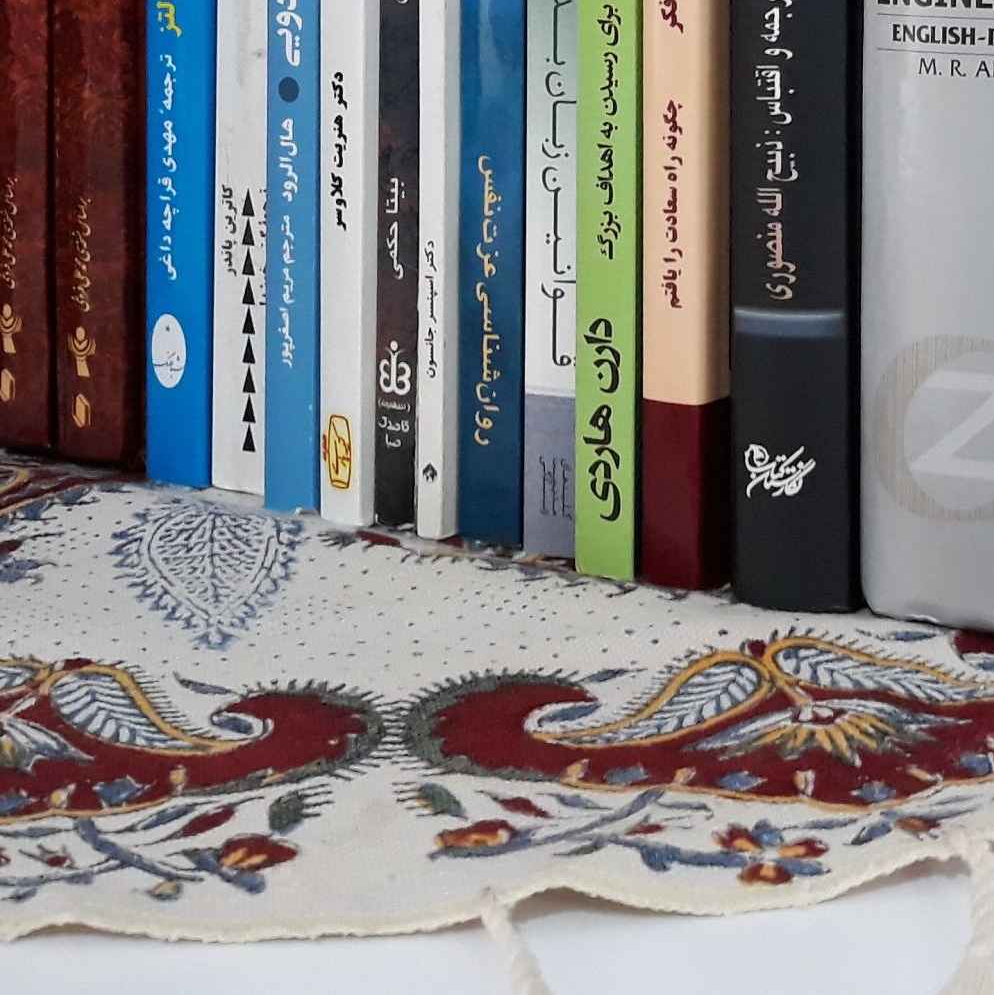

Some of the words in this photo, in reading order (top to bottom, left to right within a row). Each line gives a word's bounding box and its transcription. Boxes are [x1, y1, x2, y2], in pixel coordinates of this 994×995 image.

[596, 5, 622, 47] برای
[764, 49, 794, 60] و
[918, 57, 942, 76] M.
[950, 59, 967, 77] R.
[330, 73, 348, 110] دکتر
[597, 53, 619, 115] رسیدن
[160, 120, 177, 172] مهدی
[279, 118, 299, 156] هال
[330, 116, 348, 168] هنریت
[602, 122, 618, 138] به
[661, 100, 681, 152] چگونه
[279, 156, 299, 202] الرود
[595, 144, 614, 205] اهداف
[661, 156, 681, 183] راه
[756, 140, 799, 183] ذبیح
[221, 184, 238, 234] کاترین
[330, 173, 347, 231] کلاوسر
[386, 178, 406, 214] بیتا
[661, 186, 679, 243] سعادت
[757, 188, 784, 217] الله
[159, 235, 178, 281] داغی
[220, 240, 238, 277] پاندر
[280, 215, 295, 263] مترجم
[386, 222, 405, 279] حکمی
[423, 240, 438, 272] دکتر
[597, 211, 621, 260] بزرگ
[661, 247, 682, 264] را
[756, 222, 797, 300] منصوری
[280, 267, 295, 304] مریم
[423, 276, 441, 324] اسپنسر
[661, 268, 682, 309] یافتم
[278, 308, 295, 367] اصغرپور
[423, 328, 438, 379] جانسون
[583, 319, 621, 394] دارن
[582, 405, 621, 522] هاردی
